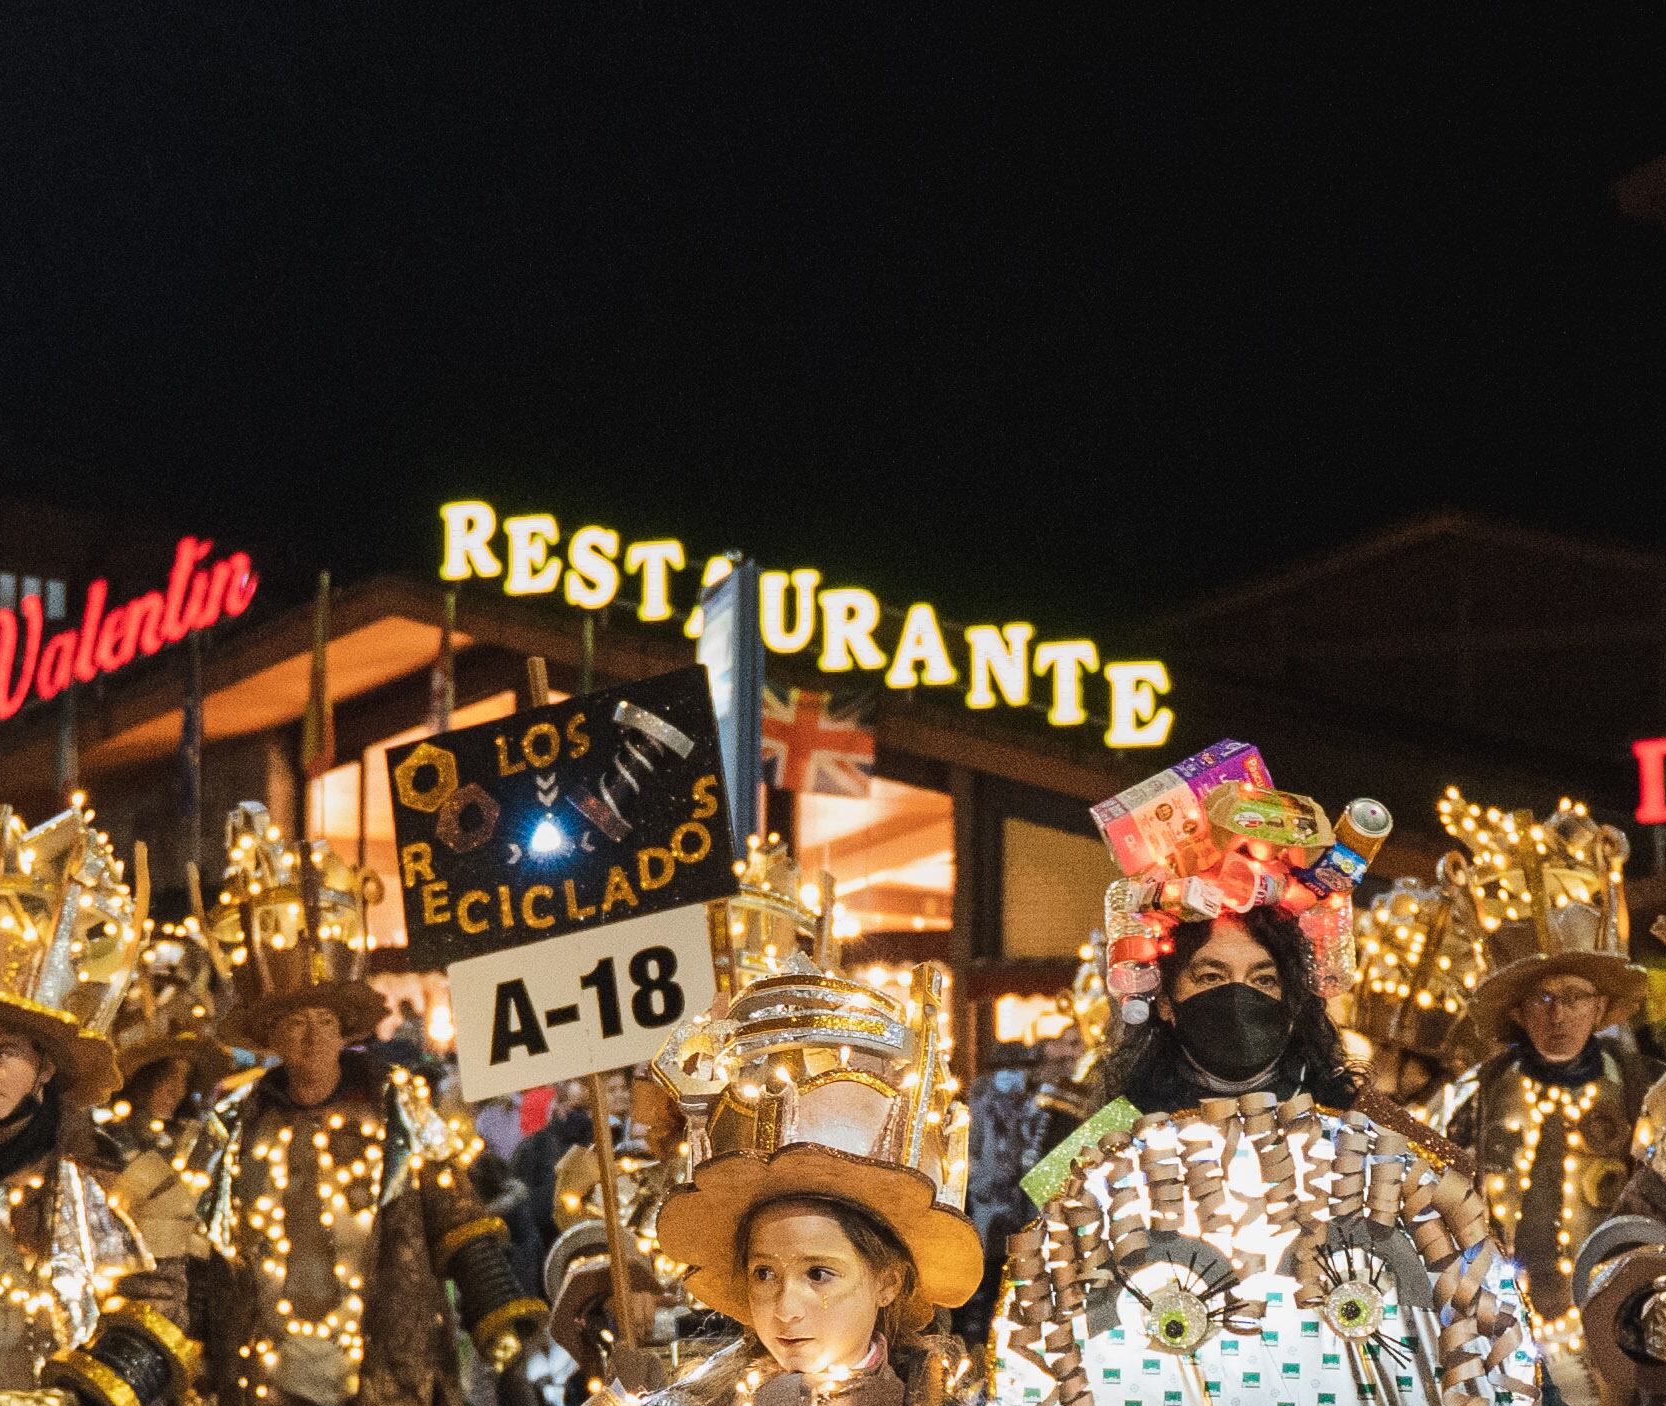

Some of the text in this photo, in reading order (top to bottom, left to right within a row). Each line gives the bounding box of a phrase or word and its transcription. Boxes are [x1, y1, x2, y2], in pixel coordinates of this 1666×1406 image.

[495, 713, 591, 778] LOS
[402, 775, 719, 934] RECICLADOS
[490, 944, 685, 1067] A-18
